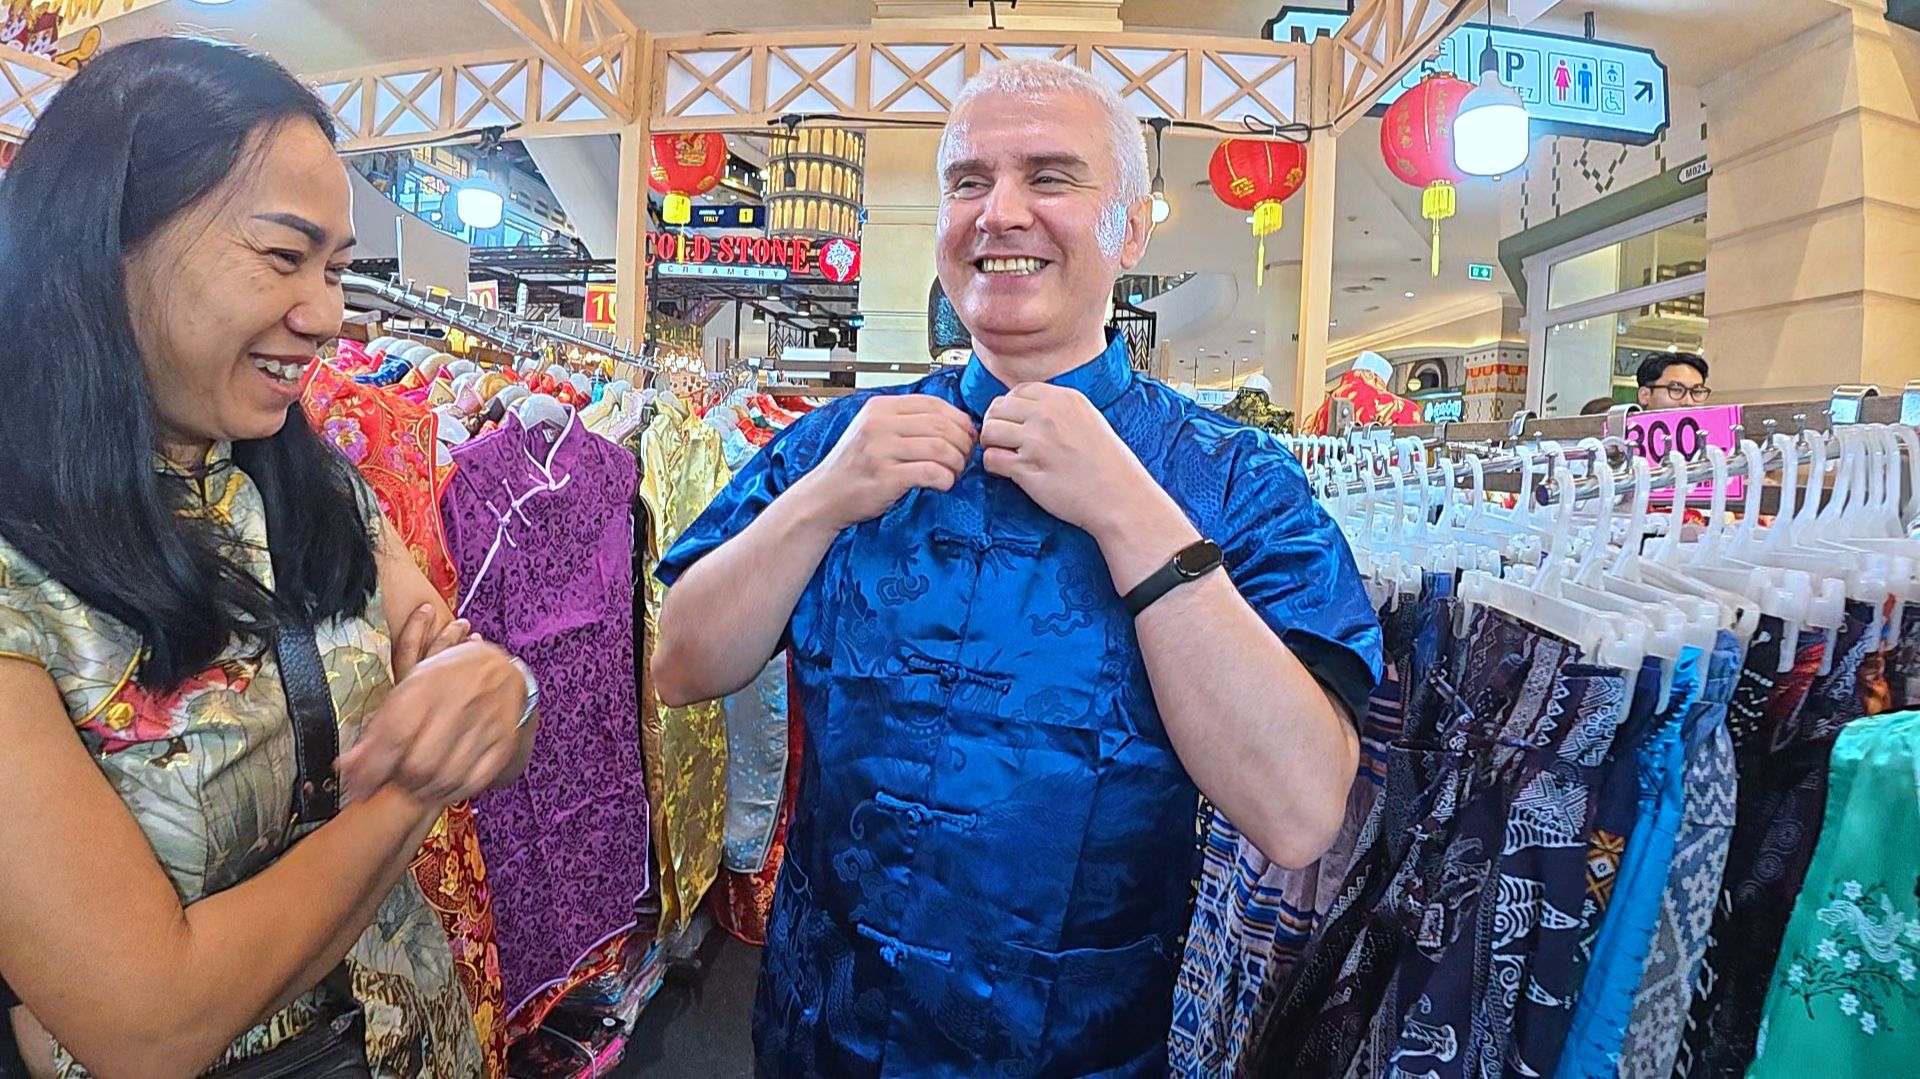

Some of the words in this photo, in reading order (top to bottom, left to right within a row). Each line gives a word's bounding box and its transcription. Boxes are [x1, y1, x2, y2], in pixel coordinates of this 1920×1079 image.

[1505, 51, 1525, 82] P
[717, 234, 812, 274] STONE
[667, 264, 779, 278] CREAMERY
